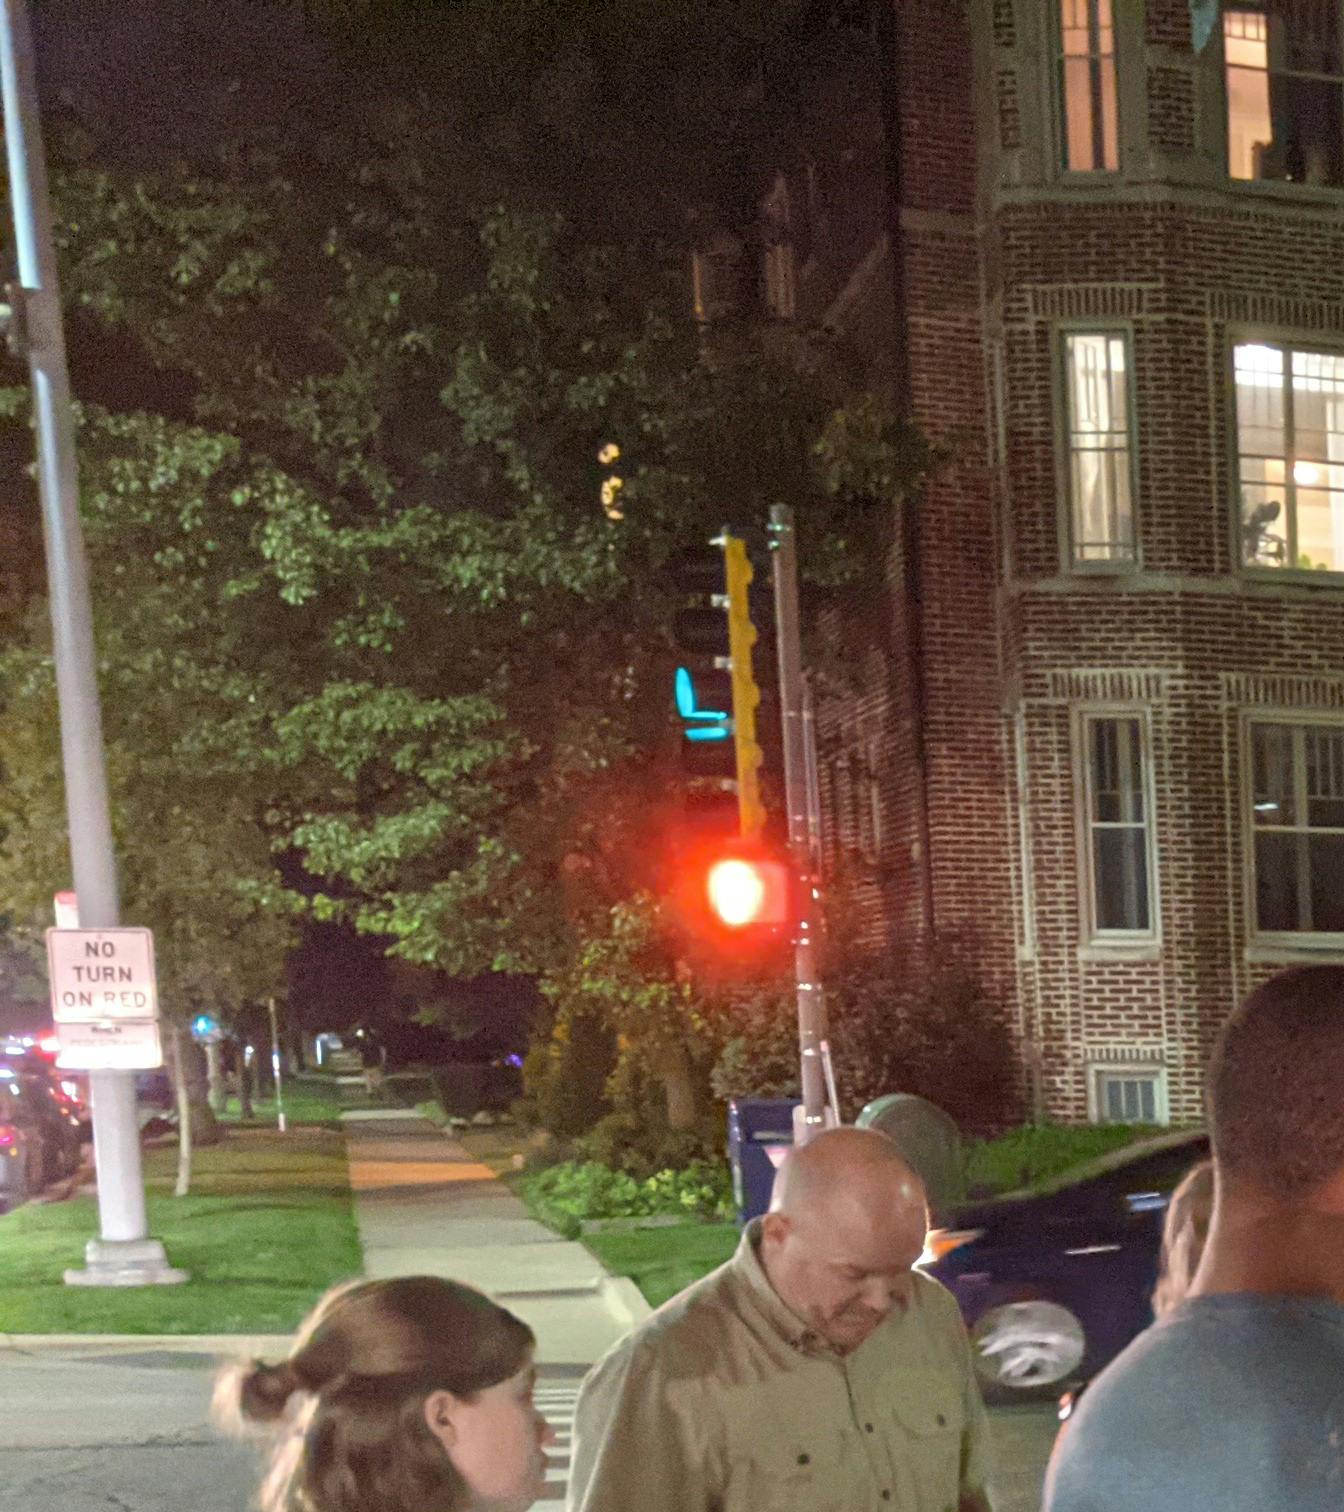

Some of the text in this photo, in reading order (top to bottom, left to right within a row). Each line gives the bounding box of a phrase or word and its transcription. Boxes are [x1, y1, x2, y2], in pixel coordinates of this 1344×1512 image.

[85, 941, 115, 957] NO
[73, 965, 132, 982] TURN
[63, 991, 147, 1007] ON RED
